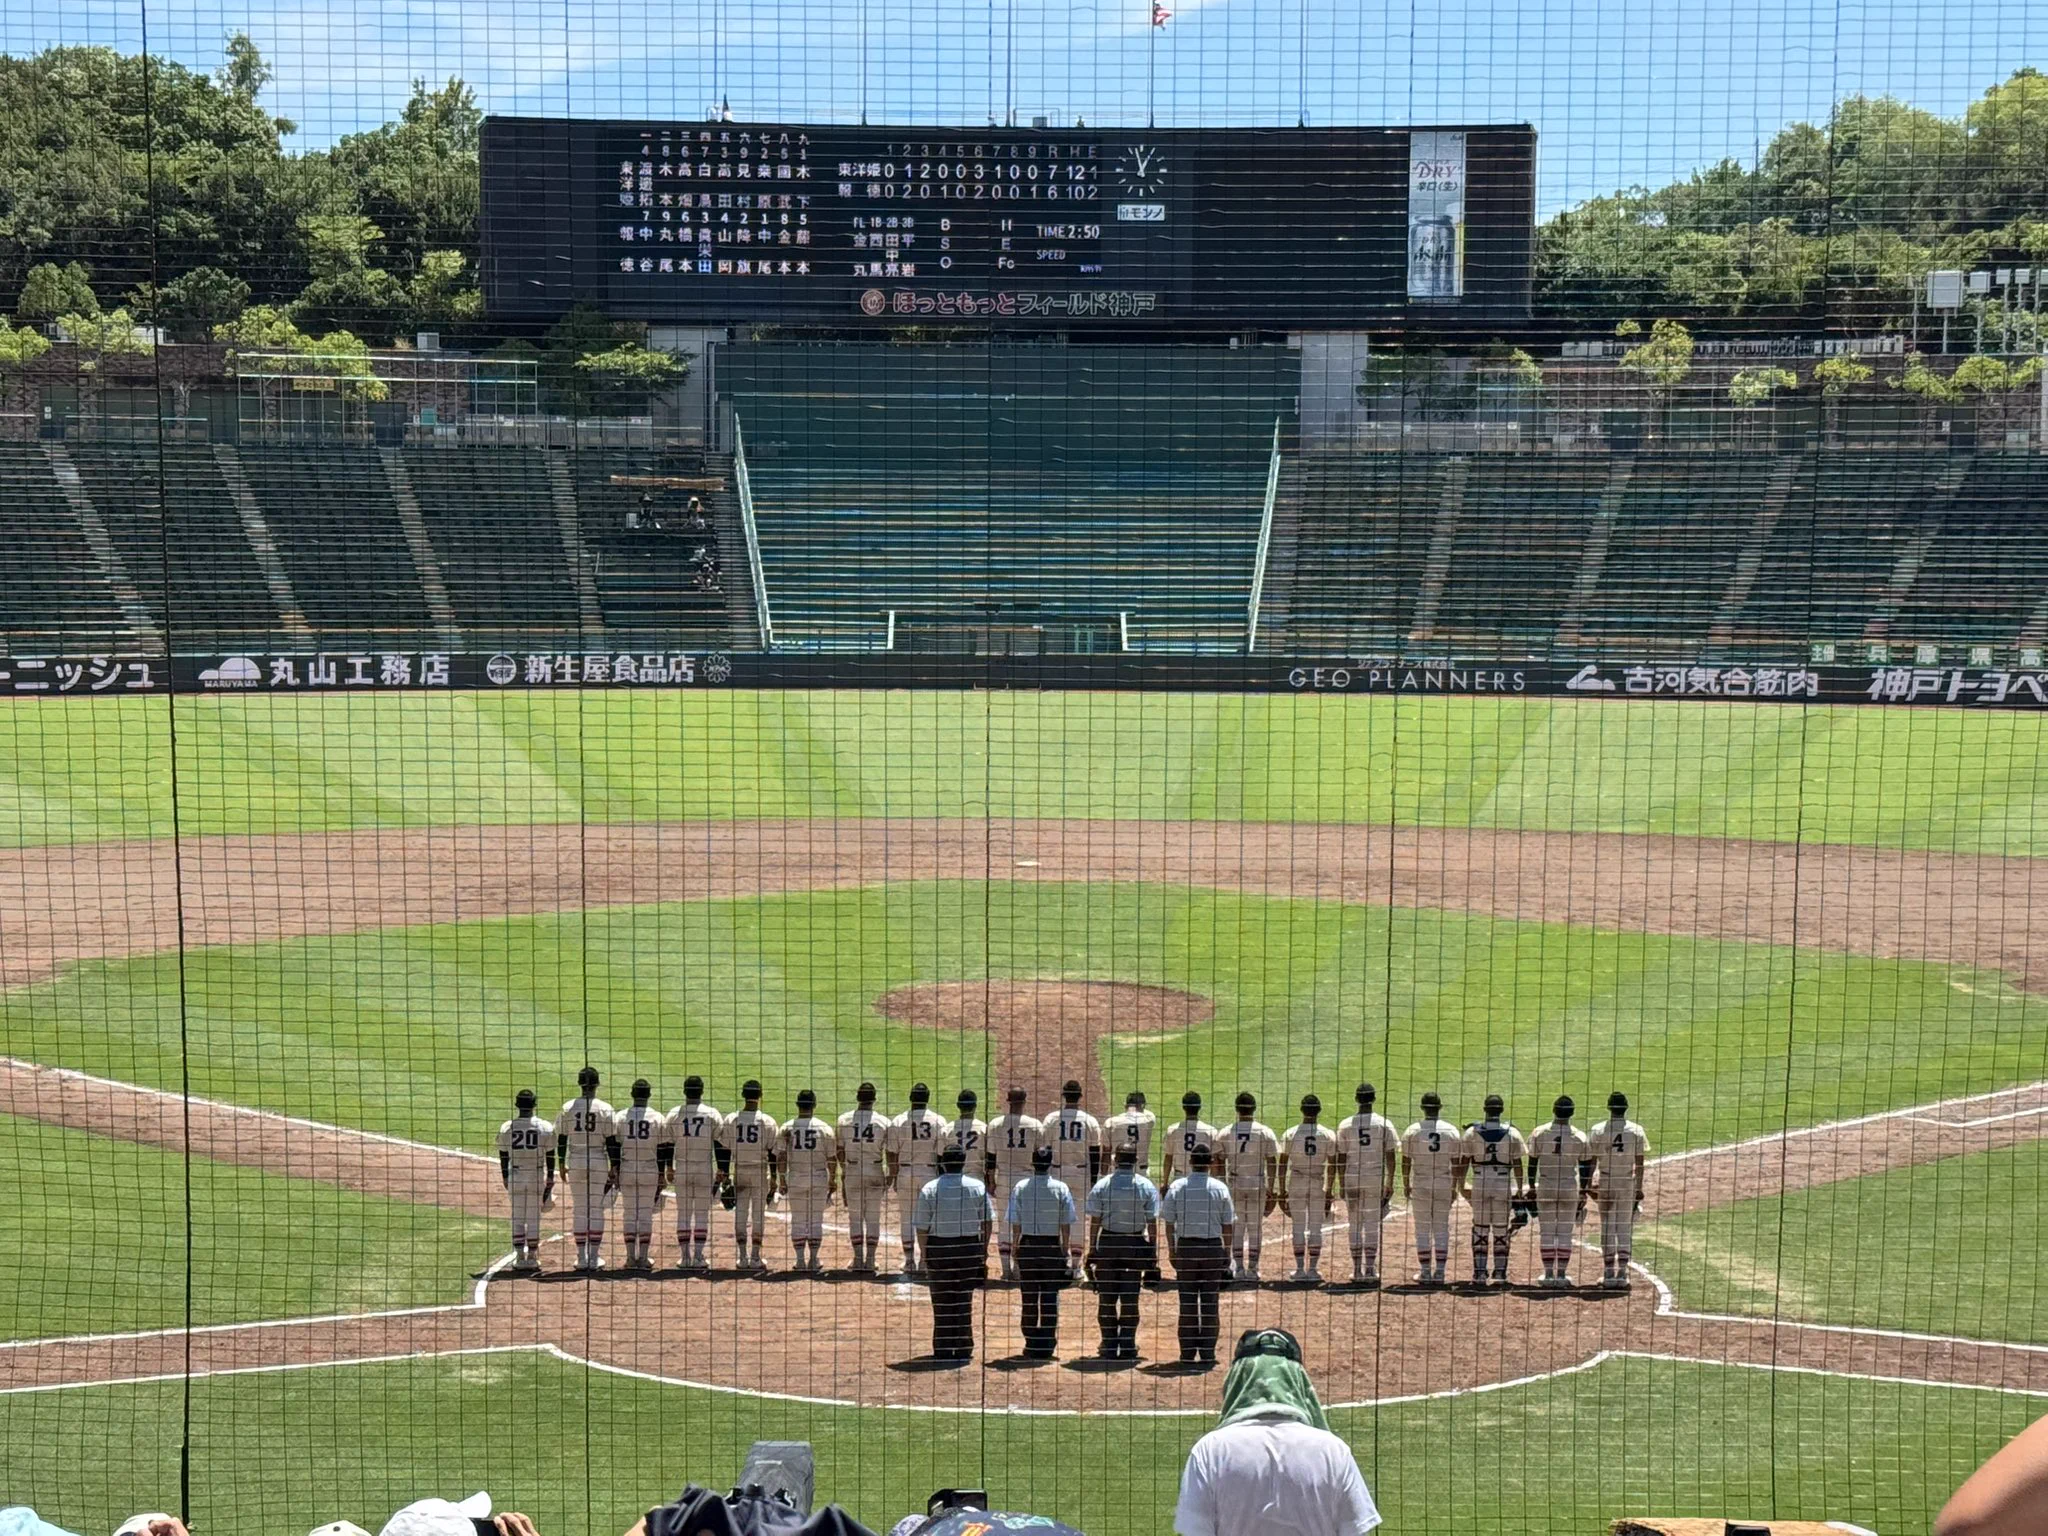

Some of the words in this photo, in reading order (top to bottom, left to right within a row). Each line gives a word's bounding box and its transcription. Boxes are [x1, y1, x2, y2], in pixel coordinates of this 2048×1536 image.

[660, 131, 671, 141] 二
[681, 131, 691, 140] 三
[700, 132, 711, 142] 四
[720, 132, 731, 143] 五
[739, 132, 750, 144] 六
[760, 132, 771, 145] 七
[779, 133, 790, 145] 八
[799, 133, 810, 145] 九
[641, 145, 650, 157] 4
[662, 145, 670, 157] 8
[681, 146, 690, 157] 6
[701, 146, 709, 158] 7
[721, 147, 728, 158] 3
[740, 147, 748, 159] 9
[761, 148, 769, 159] 2
[781, 148, 788, 160] 5
[800, 149, 807, 160] 1
[887, 144, 893, 156] 1
[903, 144, 912, 157] 2
[920, 145, 929, 157] 3
[939, 145, 947, 157] 4
[957, 145, 965, 157] 5
[974, 146, 983, 158] 6
[993, 146, 1001, 157] 7
[1010, 146, 1019, 158] 8
[1028, 146, 1037, 158] 9
[1049, 146, 1058, 158] R
[1070, 146, 1080, 158] H
[1088, 147, 1097, 158] E
[884, 163, 895, 178] 0
[904, 163, 912, 178] 1
[920, 164, 930, 178] 2
[938, 164, 948, 179] 0
[956, 164, 966, 179] 0
[974, 164, 984, 179] 3
[995, 164, 1001, 179] 1
[1010, 165, 1020, 180] 0
[1028, 165, 1038, 180] 0
[1048, 165, 1058, 180] 7
[1066, 165, 1085, 180] 12
[1090, 166, 1097, 179] 1
[884, 184, 894, 199] 0
[903, 184, 912, 199] 2
[920, 184, 930, 199] 0
[940, 185, 947, 199] 1
[956, 184, 966, 199] 0
[974, 185, 983, 199] 2
[992, 185, 1002, 200] 0
[1010, 185, 1020, 200] 0
[1030, 185, 1037, 199] 1
[1048, 185, 1058, 200] 6
[1066, 185, 1085, 200] 10
[1088, 185, 1098, 200] 2
[642, 210, 650, 221] 7
[662, 211, 670, 222] 9
[681, 211, 690, 223] 6
[701, 212, 709, 223] 3
[720, 212, 729, 224] 4
[740, 212, 748, 224] 2
[761, 213, 769, 225] 1
[780, 213, 788, 225] 8
[799, 214, 807, 225] 5
[870, 217, 882, 228] 1B
[886, 217, 898, 228] 2B
[902, 217, 914, 228] 3B
[941, 218, 951, 231] B
[1036, 225, 1065, 238] TIME
[1068, 225, 1100, 239] 2:50
[941, 236, 950, 250] S
[1001, 237, 1011, 250] E
[1036, 250, 1067, 260] SPEED
[892, 292, 1156, 316] ほっともっとフィールド神戸
[270, 656, 450, 686] 丸山工務店
[524, 654, 696, 684] 新生屋食品店
[1289, 667, 1351, 688] GEO
[1369, 669, 1525, 692] PLANNERS
[1623, 666, 1819, 698] 古河気合筋肉
[627, 1119, 650, 1140] 18
[682, 1116, 705, 1138] 17
[735, 1123, 759, 1144] 16
[853, 1122, 875, 1143] 14
[911, 1121, 932, 1141] 13
[1058, 1120, 1082, 1142] 10
[511, 1129, 538, 1150] 20
[793, 1129, 817, 1150] 15
[954, 1130, 978, 1150] 12
[1006, 1127, 1027, 1149] 11
[1183, 1132, 1196, 1151] 8
[1237, 1133, 1251, 1153] 7
[1303, 1135, 1317, 1156] 6
[1358, 1128, 1371, 1147] 5
[1428, 1132, 1441, 1152] 3
[1551, 1135, 1563, 1155] 1
[1612, 1133, 1625, 1153] 4
